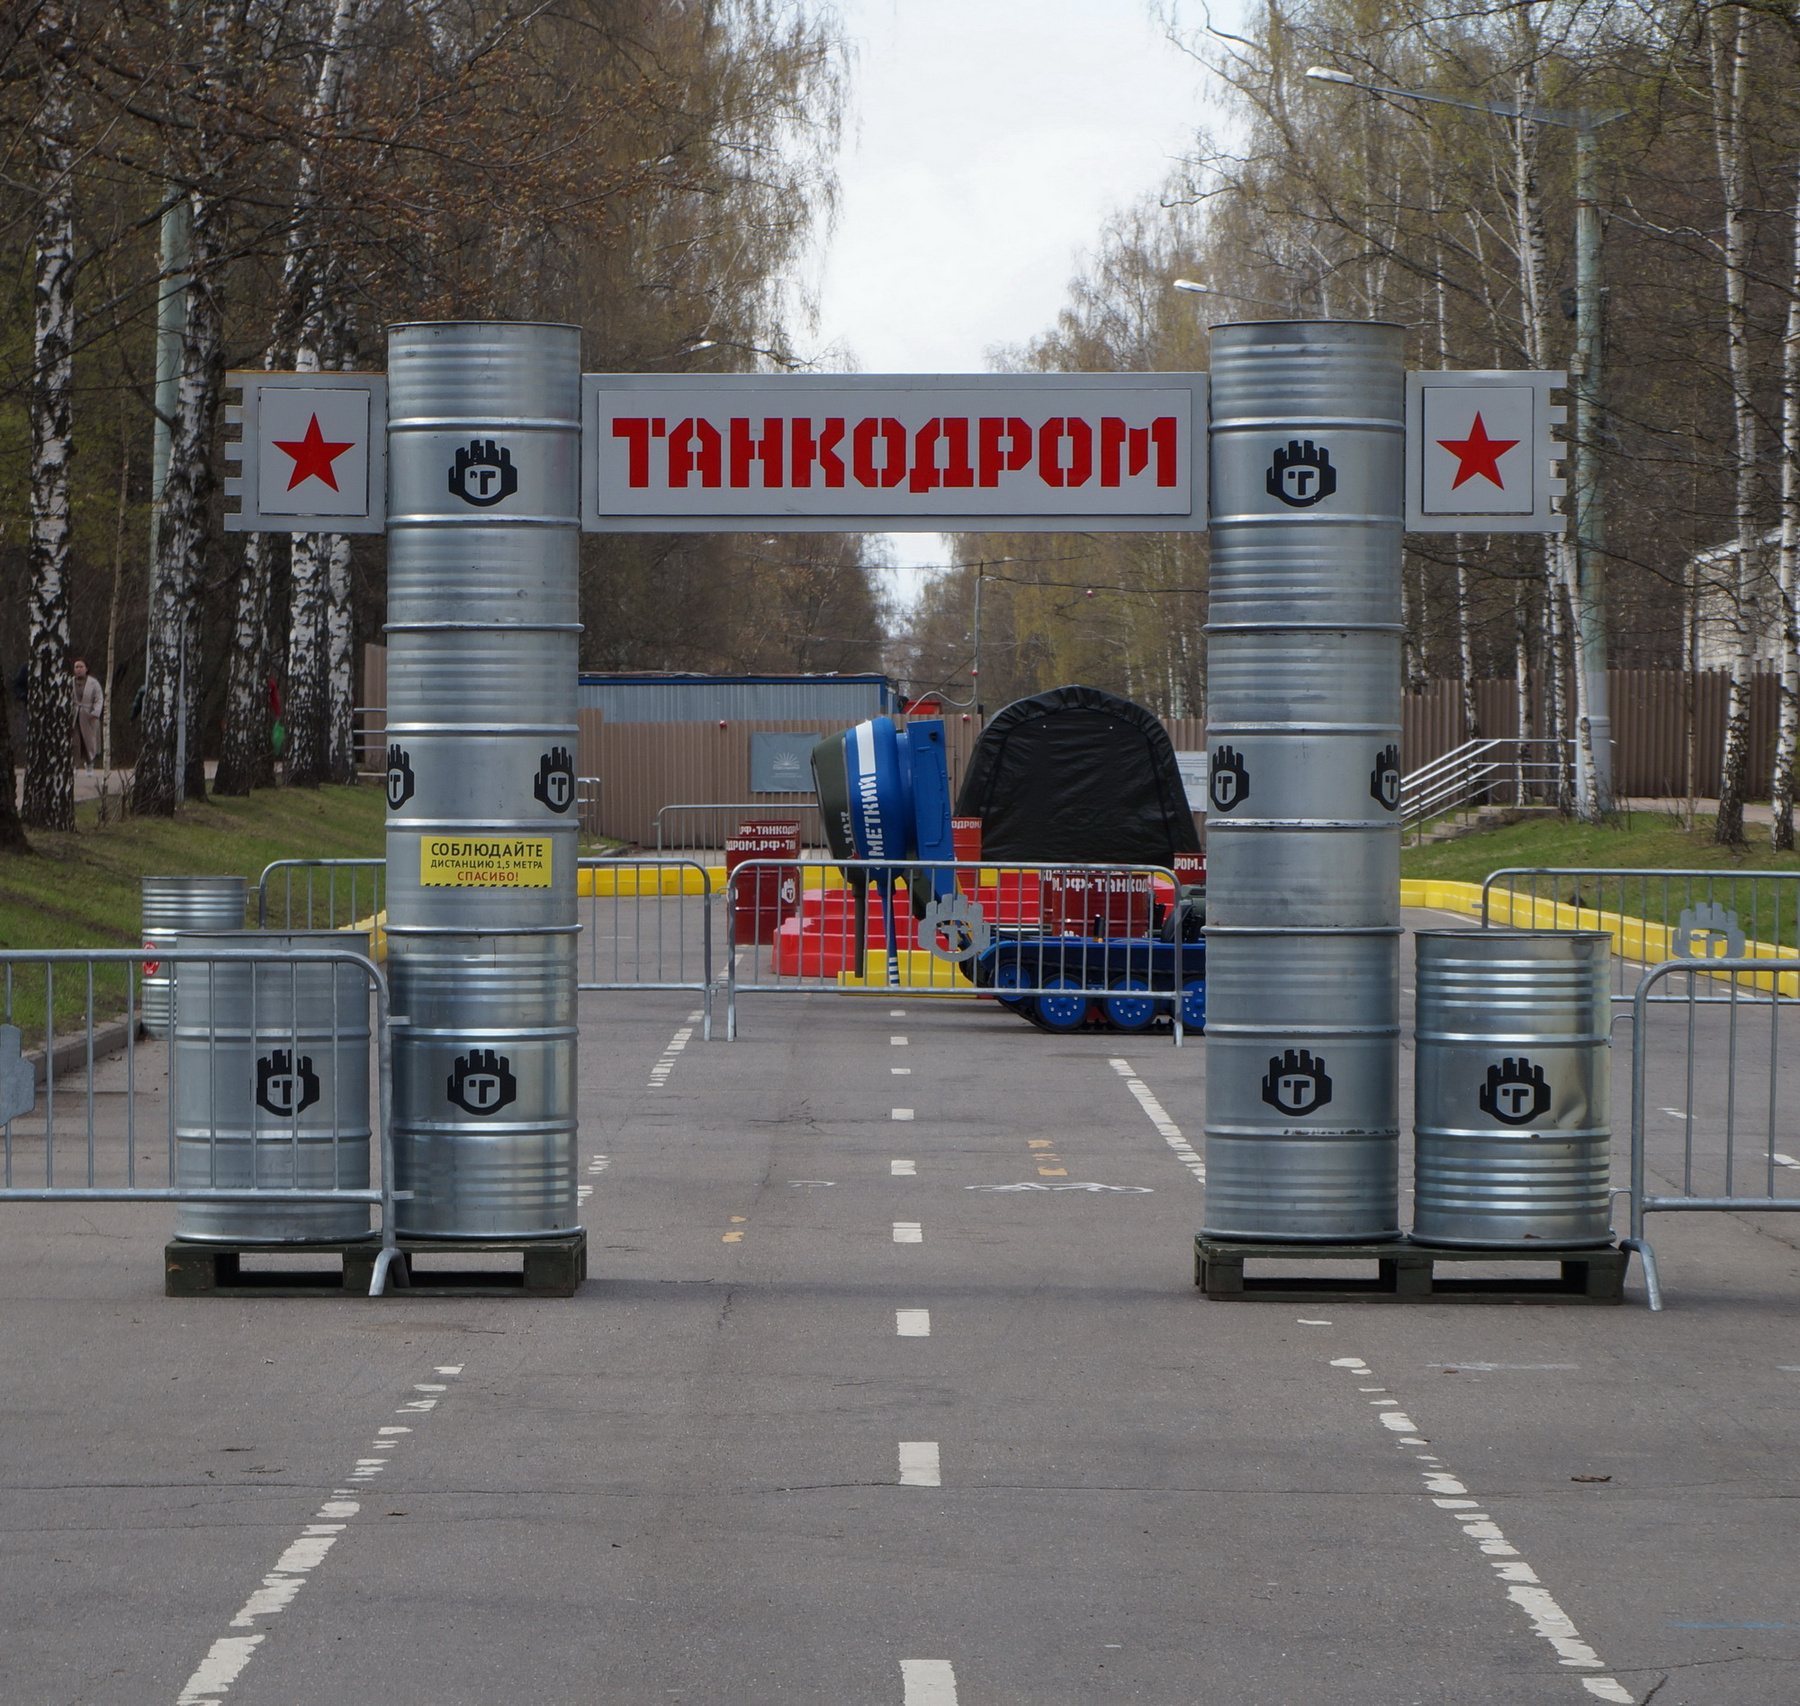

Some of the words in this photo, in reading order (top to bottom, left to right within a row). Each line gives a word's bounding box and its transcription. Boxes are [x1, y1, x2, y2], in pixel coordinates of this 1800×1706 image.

[613, 417, 1177, 493] ТАНКОДРОМ
[431, 841, 543, 858] СОБЛЮДАЙТЕ
[430, 859, 494, 869] ДИСТАНЦИЮ
[496, 860, 510, 869] 1,5
[513, 860, 543, 869] МЕТРА
[457, 871, 519, 882] СПАСИБО!
